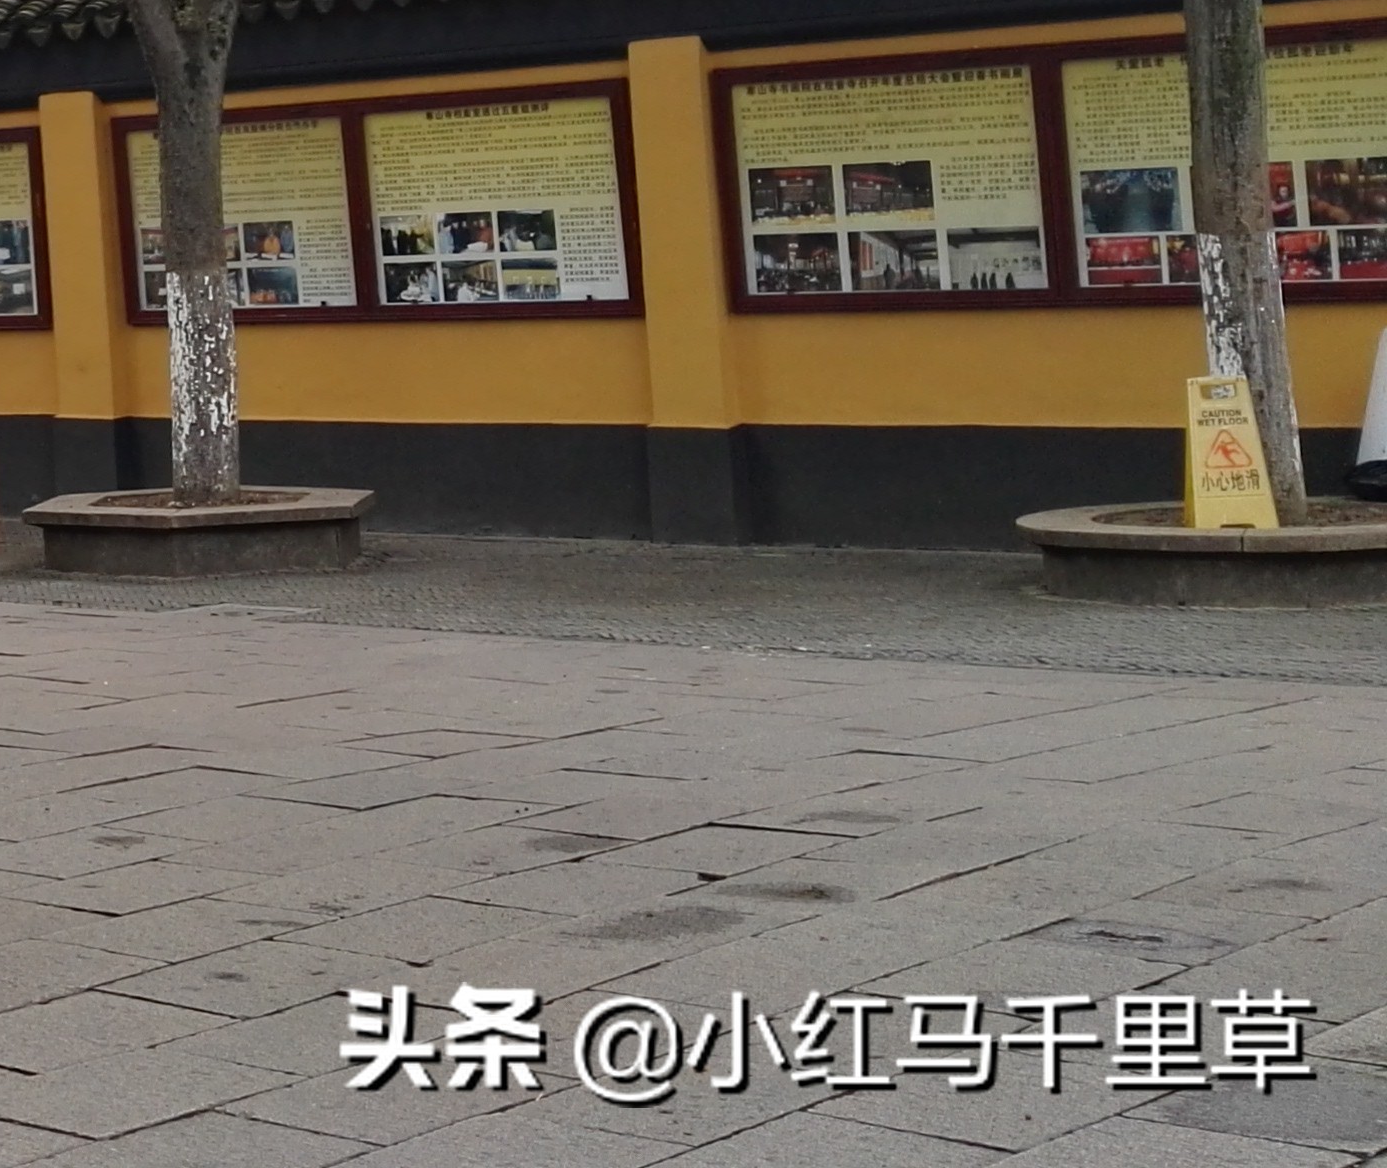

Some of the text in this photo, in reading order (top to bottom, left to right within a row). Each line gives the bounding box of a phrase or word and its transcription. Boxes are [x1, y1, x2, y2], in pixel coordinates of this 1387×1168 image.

[1202, 409, 1242, 418] CAUTION
[1197, 417, 1249, 426] WET FLOOR
[1201, 469, 1260, 492] 小心地滑
